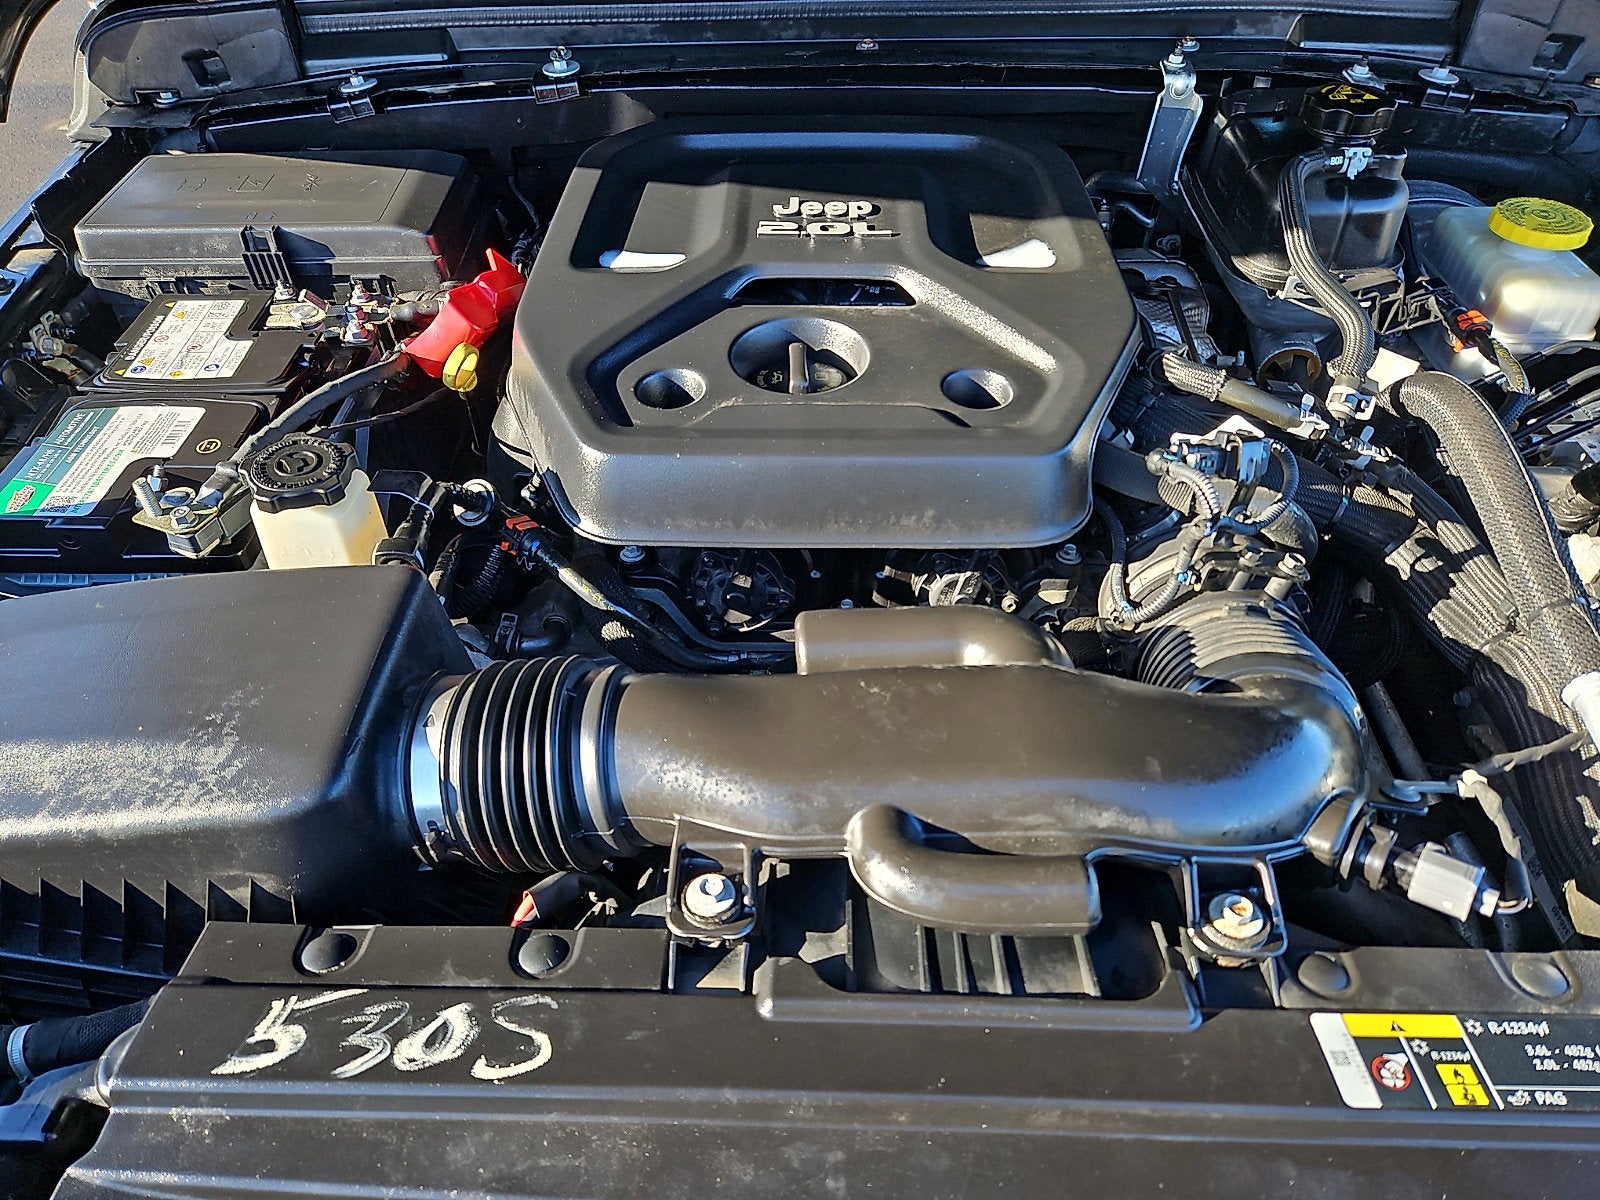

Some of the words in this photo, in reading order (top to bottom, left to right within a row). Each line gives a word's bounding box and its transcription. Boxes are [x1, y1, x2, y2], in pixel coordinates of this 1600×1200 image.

[772, 196, 874, 219] Jeep
[756, 220, 894, 239] 2.0L
[1487, 1020, 1550, 1038] R-1234yf
[1534, 1090, 1568, 1106] PAG
